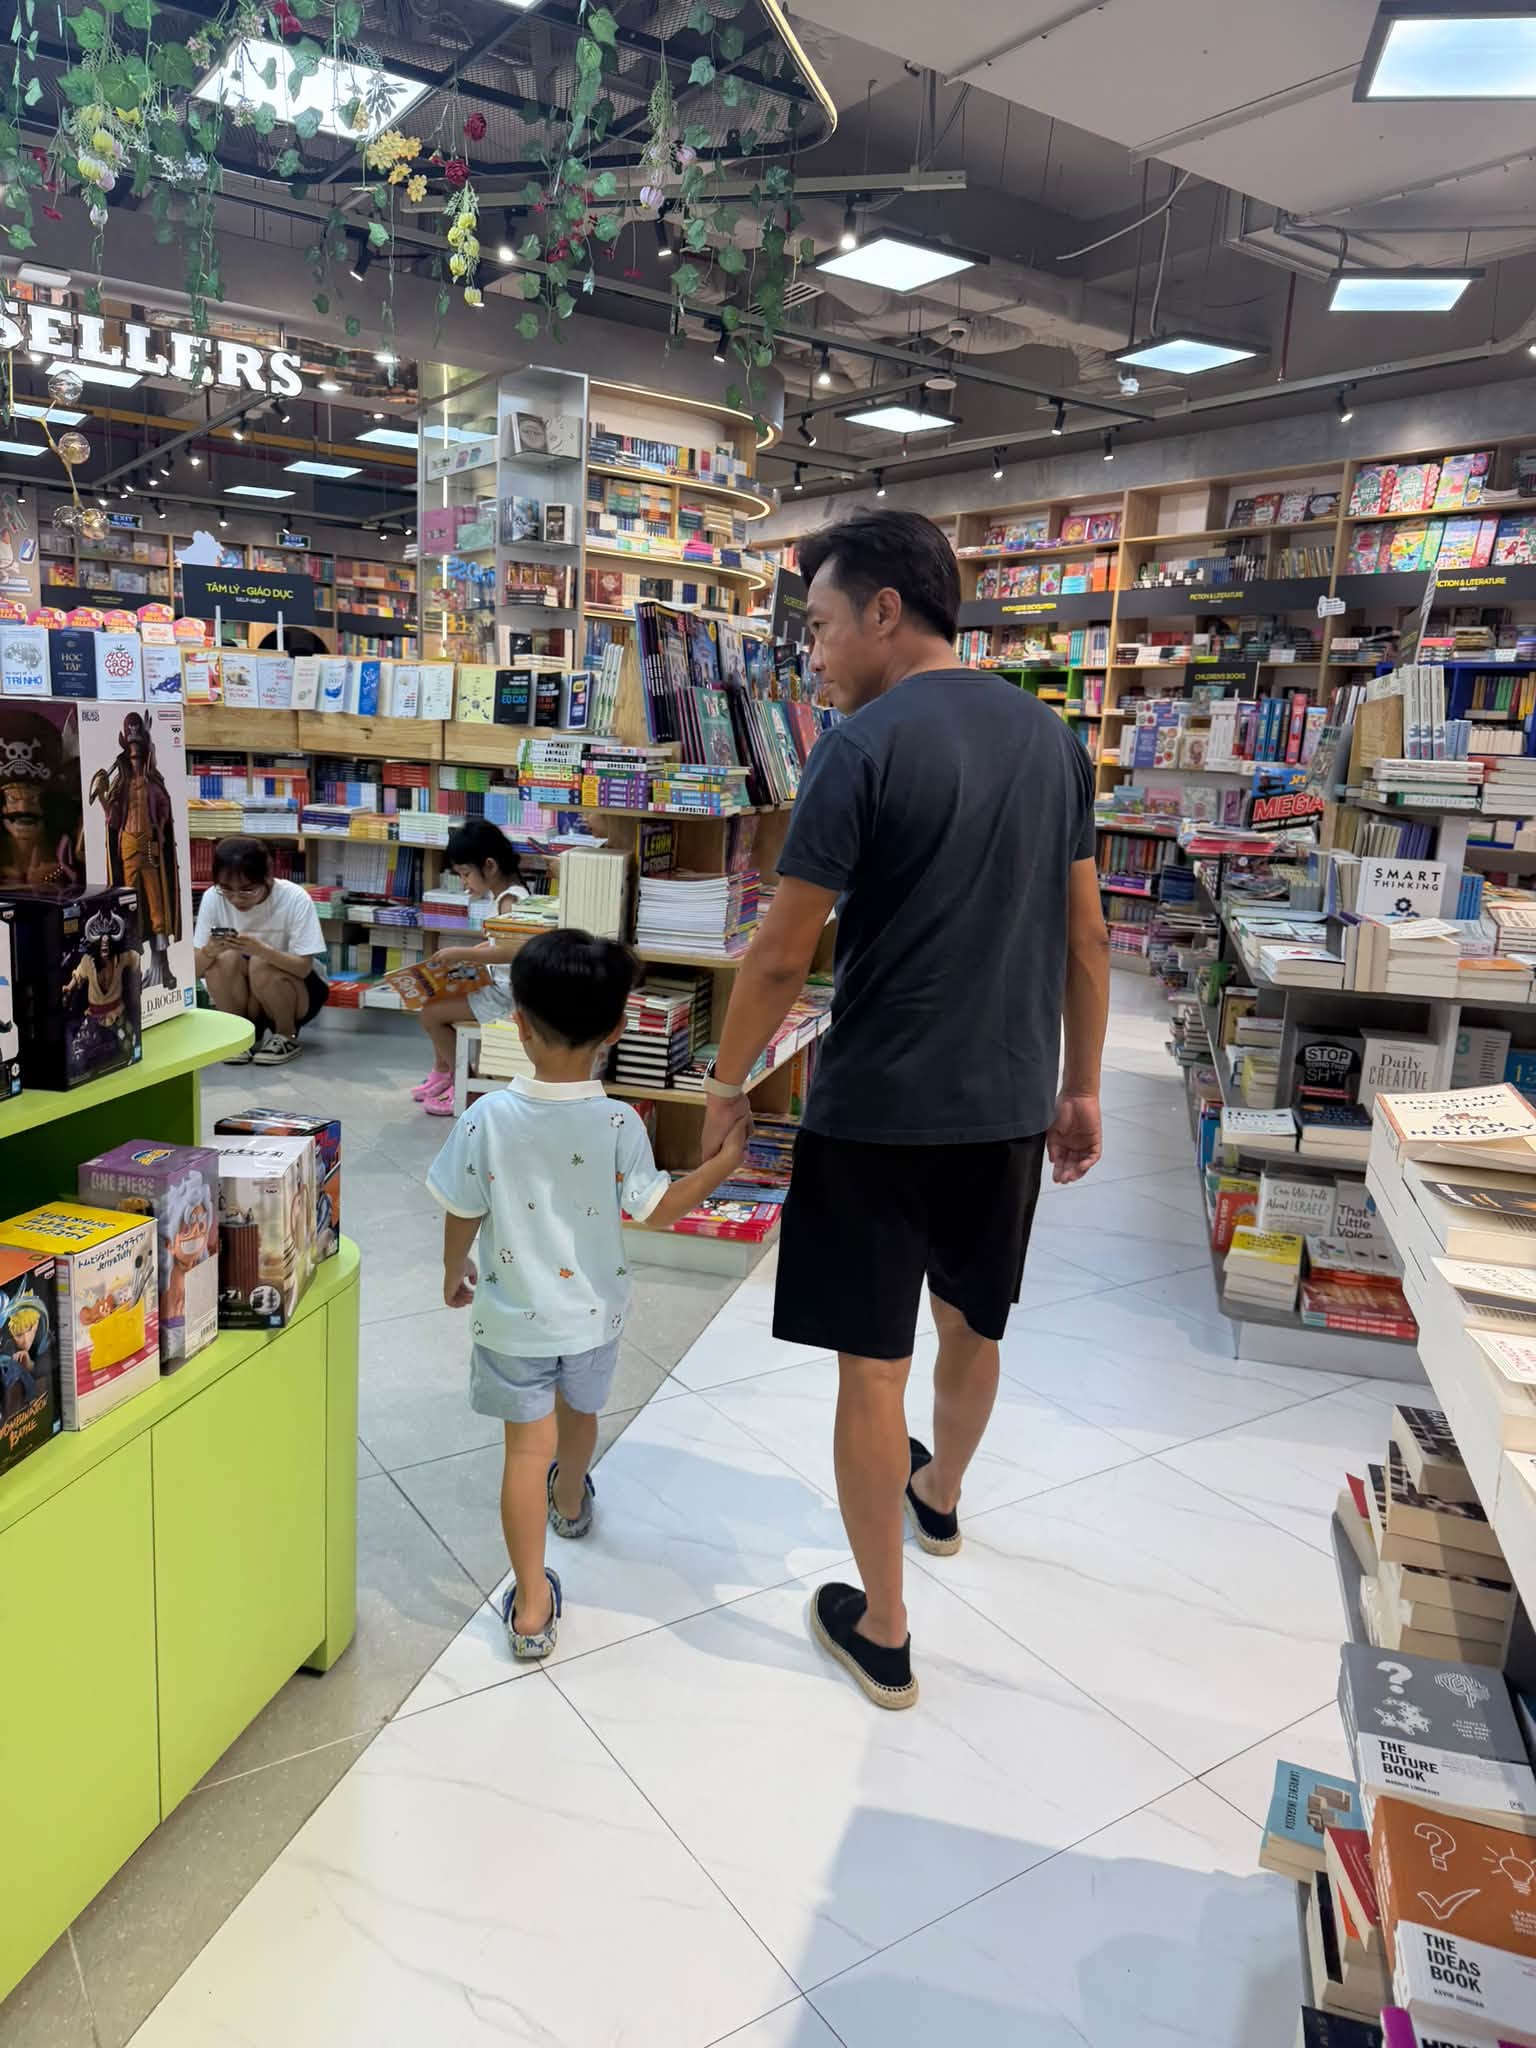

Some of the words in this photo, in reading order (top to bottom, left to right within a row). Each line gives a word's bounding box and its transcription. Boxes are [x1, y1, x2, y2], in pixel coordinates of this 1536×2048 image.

[0, 298, 302, 398] SELLERS
[1466, 576, 1507, 586] LITERATURE
[206, 581, 227, 593] TÂM
[229, 583, 240, 594] LÝ
[247, 585, 272, 597] GIÁO
[273, 589, 294, 600] DỤC
[1252, 792, 1325, 821] MEGA
[1375, 868, 1440, 882] SMART
[1374, 880, 1439, 891] THINKING
[1308, 1048, 1349, 1061] STOP
[1380, 1053, 1421, 1070] Daily
[1368, 1066, 1429, 1090] CREATIVE
[1394, 1093, 1506, 1105] DISCIPLINE
[1413, 1100, 1498, 1110] DESTINY
[1410, 1124, 1534, 1136] HOLIDAY
[1432, 1122, 1505, 1130] RYAN
[91, 1171, 115, 1192] ONE
[117, 1173, 156, 1196] PIECE
[1338, 1204, 1368, 1217] That
[1337, 1216, 1371, 1229] Little
[1336, 1227, 1373, 1240] Voice
[1378, 1739, 1407, 1756] THE
[1381, 1752, 1439, 1775] FUTURE
[1383, 1763, 1427, 1783] BOOK
[1423, 1932, 1458, 1955] THE
[1427, 1949, 1481, 1978] IDEAS
[1430, 1966, 1483, 1994] BOOK
